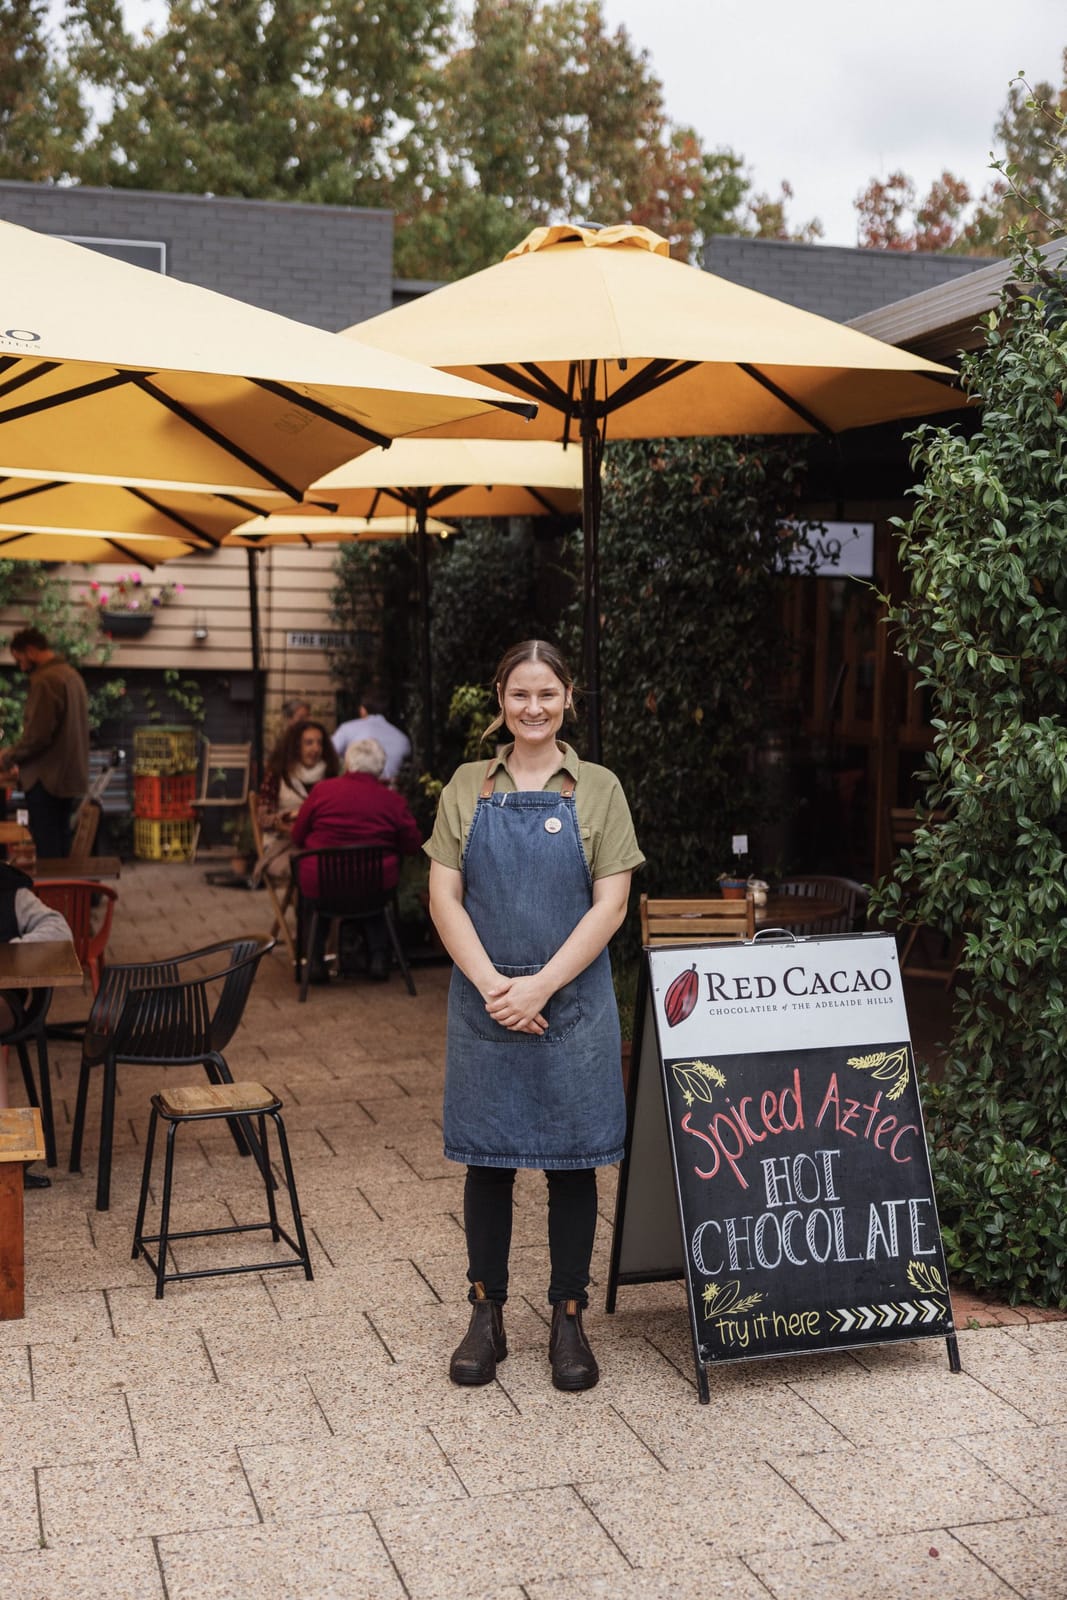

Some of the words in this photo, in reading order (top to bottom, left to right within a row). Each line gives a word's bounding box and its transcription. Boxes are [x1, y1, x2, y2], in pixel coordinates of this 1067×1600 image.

[703, 971, 777, 1002] RED
[783, 966, 892, 997] CACAO
[709, 1003, 778, 1016] CHOCOLATIER
[792, 1002, 811, 1010] THE
[815, 999, 862, 1009] ADELAIDE
[867, 996, 894, 1005] HILLS
[681, 1068, 805, 1190] Spiced
[760, 1150, 841, 1209] HOT
[691, 1198, 937, 1276] CHOCOLATE
[714, 1318, 750, 1347] try
[752, 1312, 768, 1339] it
[772, 1311, 821, 1338] here
